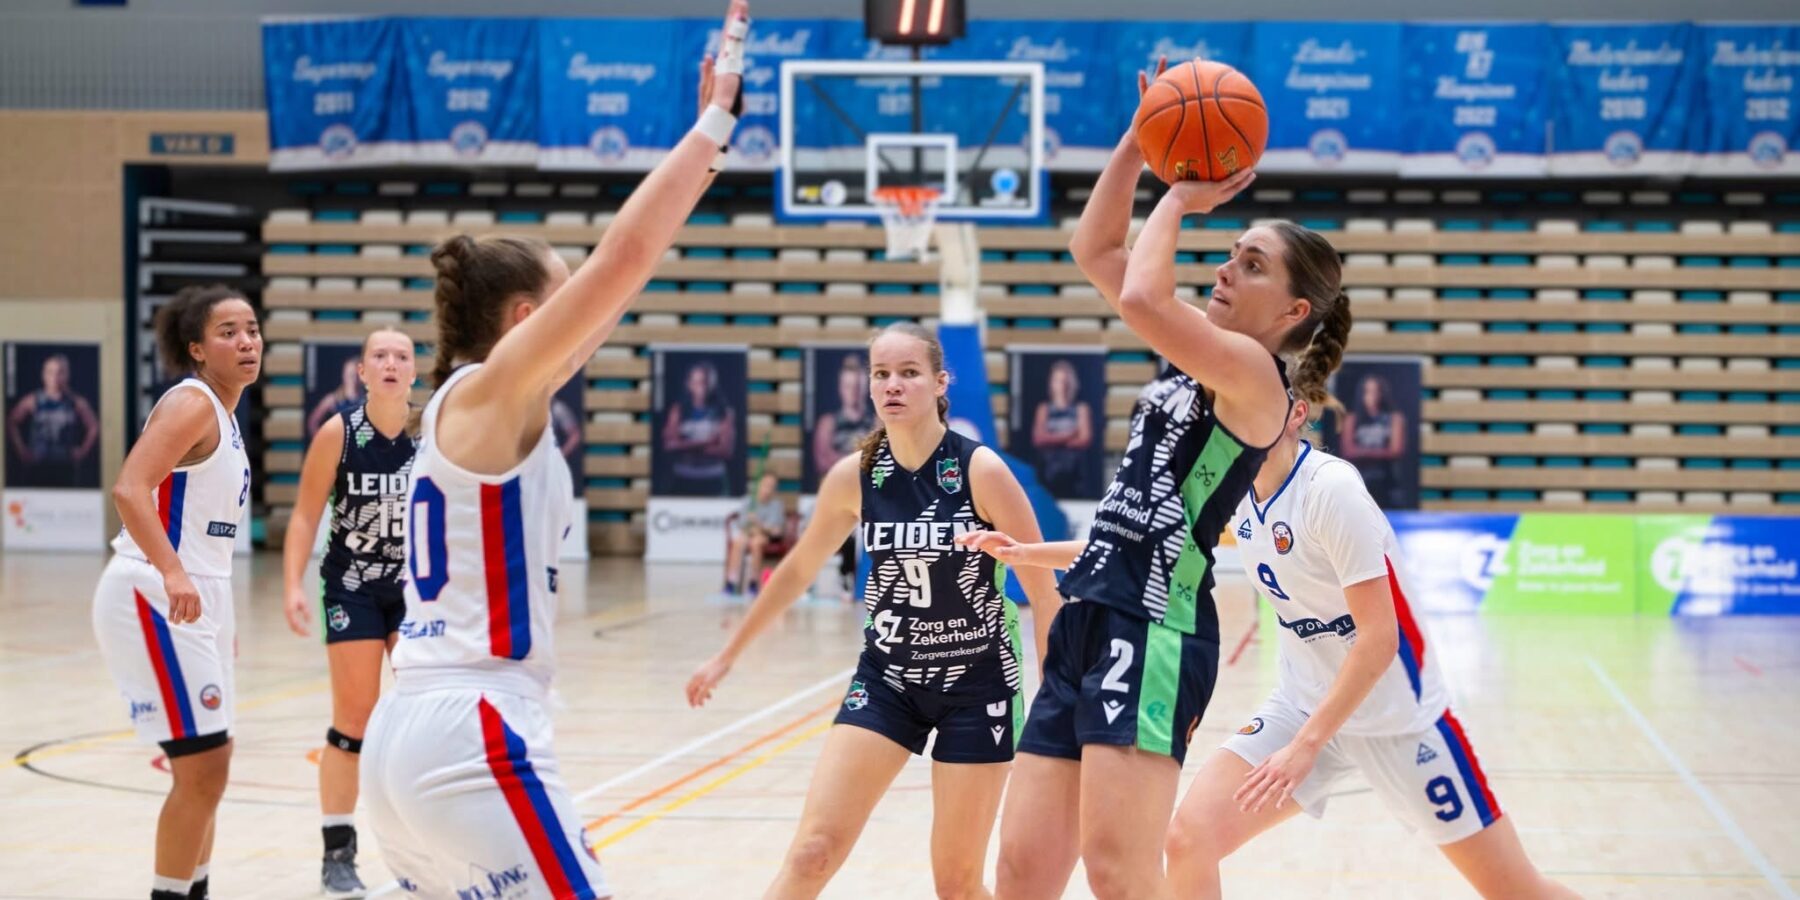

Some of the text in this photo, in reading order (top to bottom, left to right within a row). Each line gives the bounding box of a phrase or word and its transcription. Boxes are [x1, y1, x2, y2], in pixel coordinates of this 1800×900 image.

[347, 472, 408, 495] LEID
[1124, 487, 1143, 503] en
[864, 522, 981, 553] LEIDEN
[903, 558, 932, 608] 9
[1257, 563, 1290, 601] 9
[908, 617, 968, 633] Zorg en
[909, 624, 988, 646] Zekerheid
[911, 643, 990, 660] Zorgverzekeraar
[1101, 638, 1134, 693] 2
[1416, 751, 1438, 766] PEAK
[1425, 775, 1464, 823] 9
